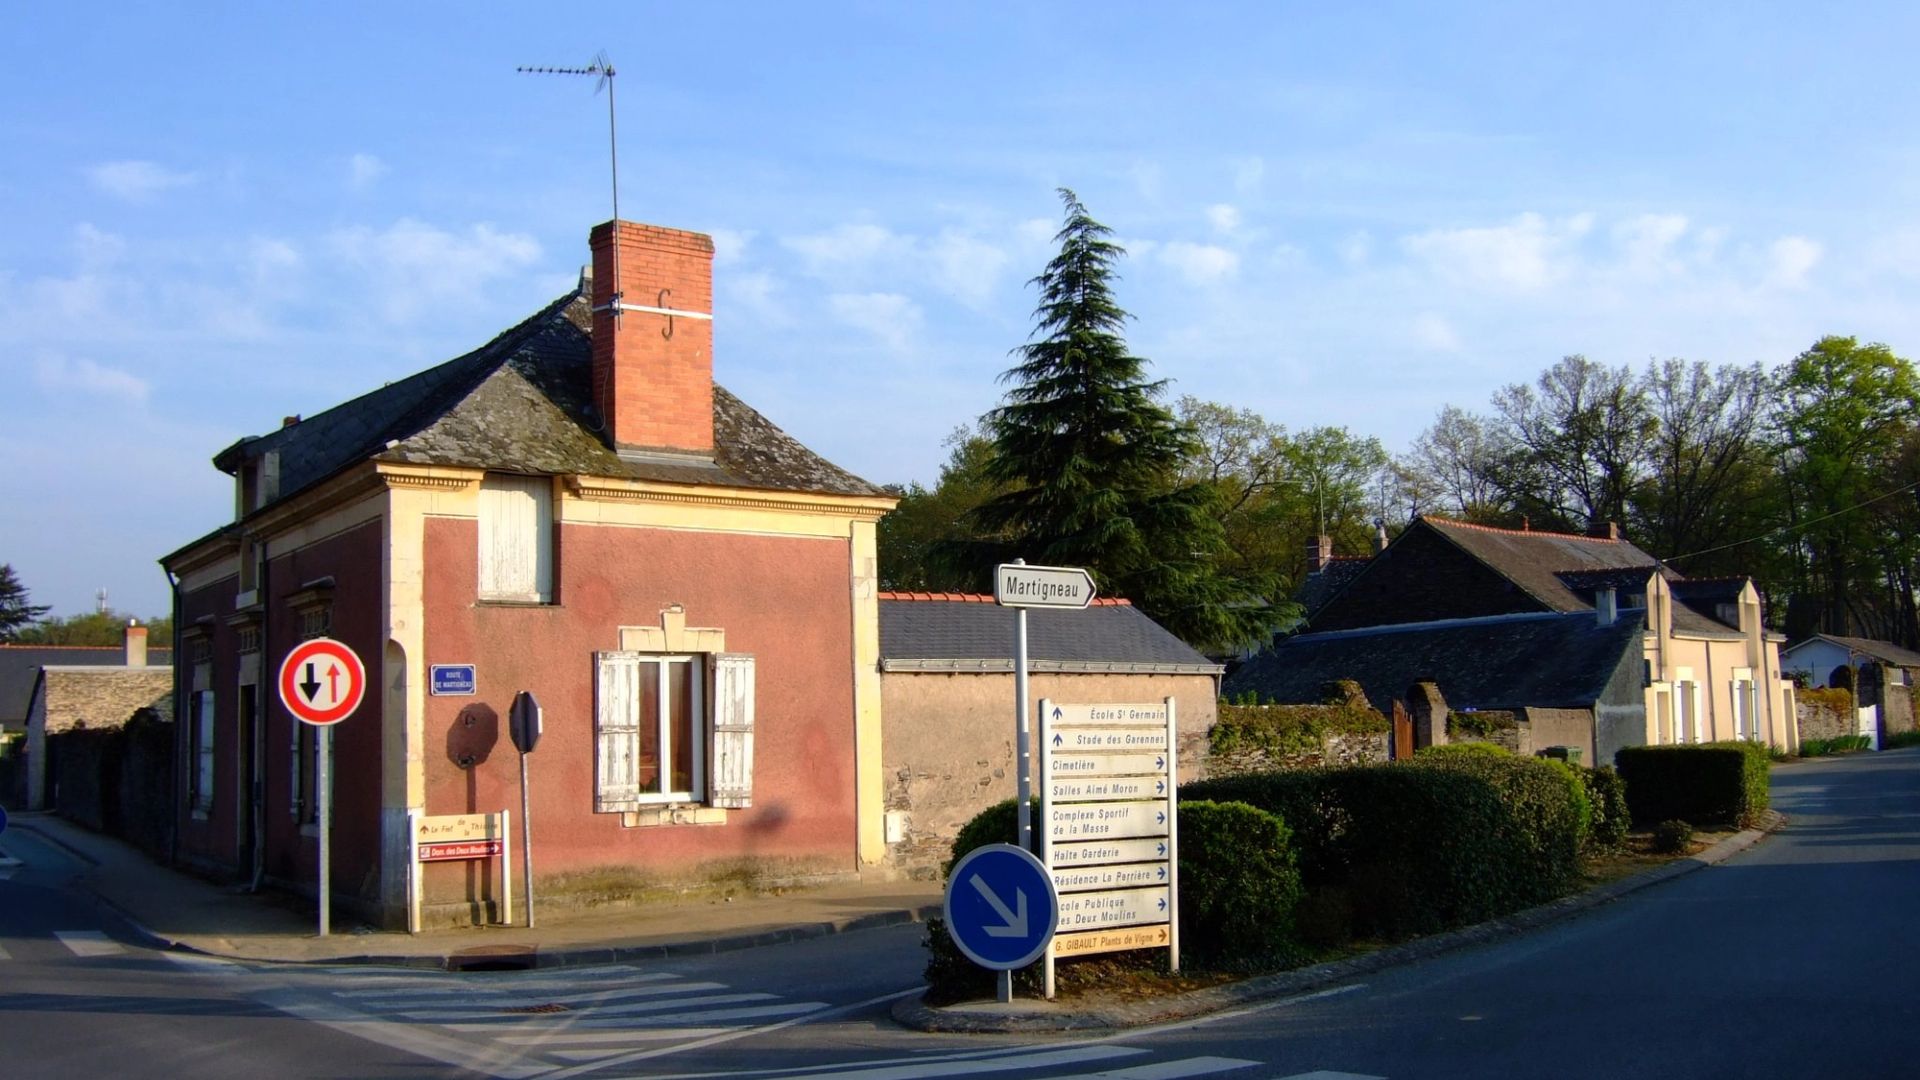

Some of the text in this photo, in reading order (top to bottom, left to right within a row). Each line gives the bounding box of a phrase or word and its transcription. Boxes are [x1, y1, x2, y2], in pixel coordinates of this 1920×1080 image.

[1006, 576, 1078, 600] Martigneau
[1090, 708, 1114, 720] École
[1130, 710, 1165, 720] Germain
[1076, 734, 1164, 744] Stade des Garennes
[1052, 760, 1095, 770] Cimetière
[1053, 784, 1138, 796] Salles Aimé Moron
[1053, 808, 1129, 822] Complexe Sportif
[1054, 824, 1109, 835] de la Masse
[1054, 848, 1119, 860] Halte Garderie
[1054, 870, 1150, 886] Résidence La Perrière
[1060, 898, 1124, 911] cole Publique
[1058, 910, 1136, 926] es Deux Moulins
[1056, 934, 1154, 952] G. GIBAULT Plants de Vigne
